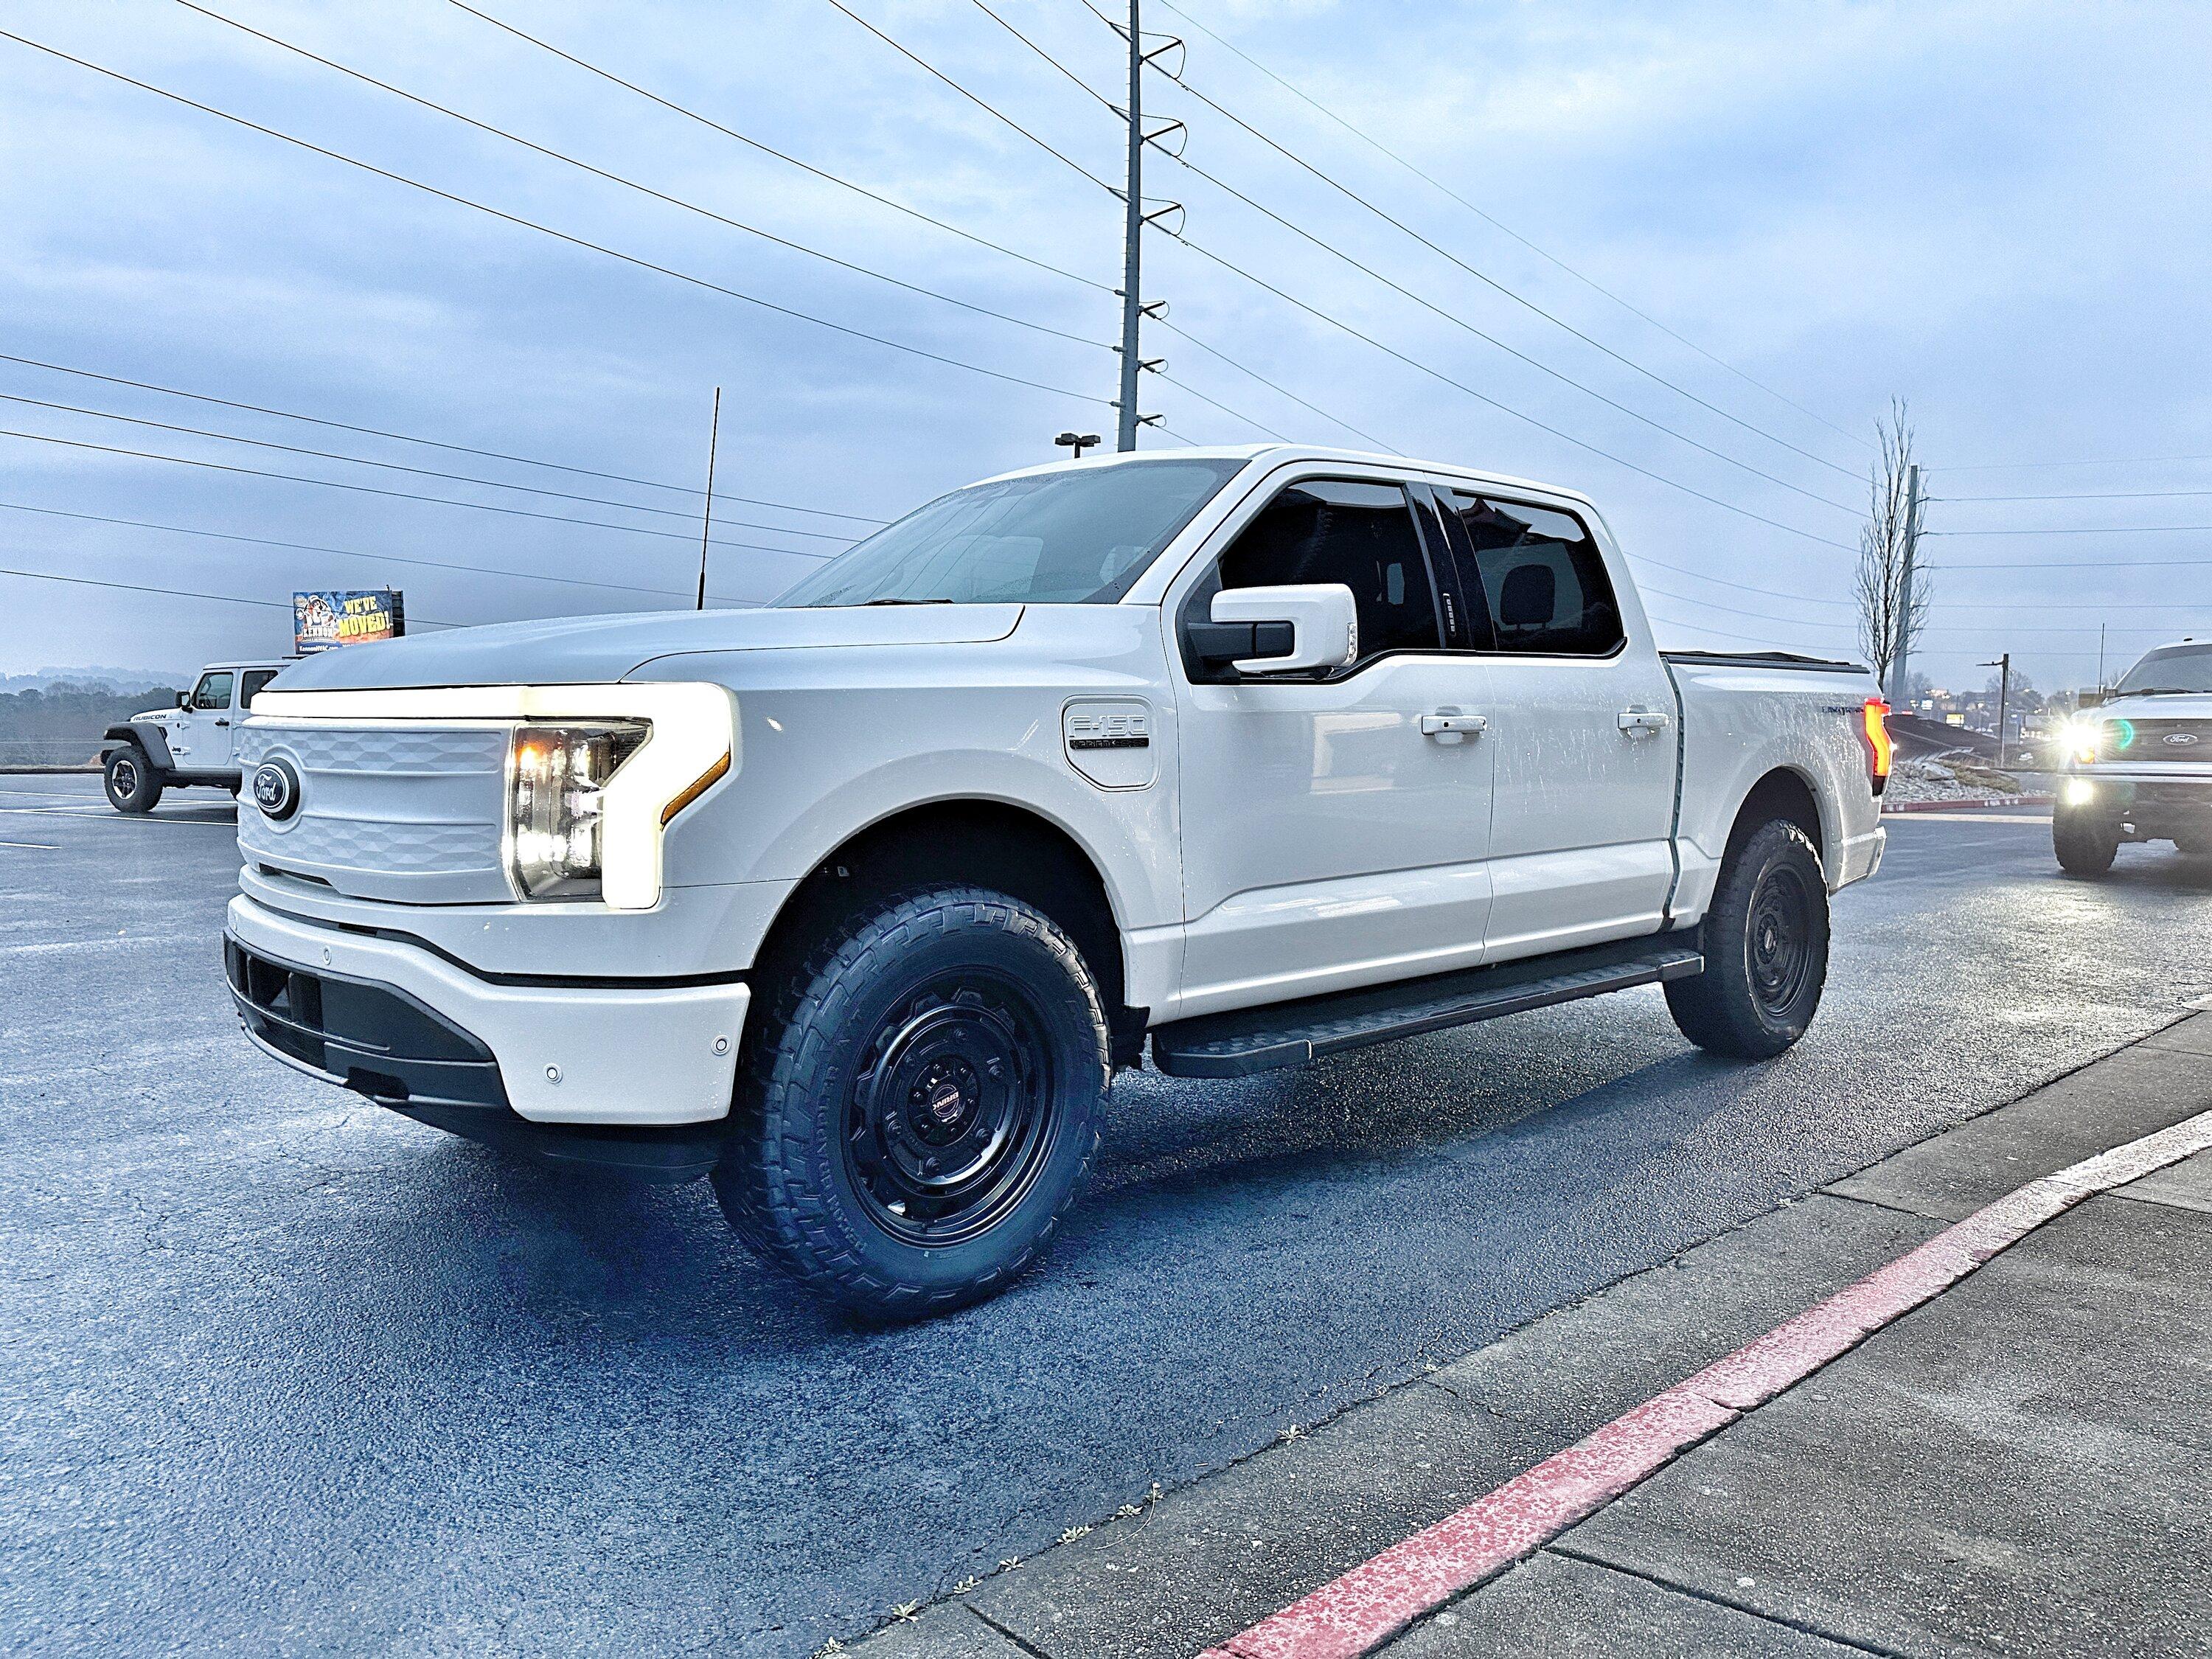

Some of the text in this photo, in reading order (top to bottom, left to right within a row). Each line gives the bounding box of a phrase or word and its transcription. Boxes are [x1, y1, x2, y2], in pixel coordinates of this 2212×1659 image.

[344, 597, 378, 613] WE'VE
[302, 627, 334, 638] KENNON
[338, 611, 391, 637] MOVED!
[1068, 715, 1149, 737] F-150
[256, 773, 276, 801] Ford
